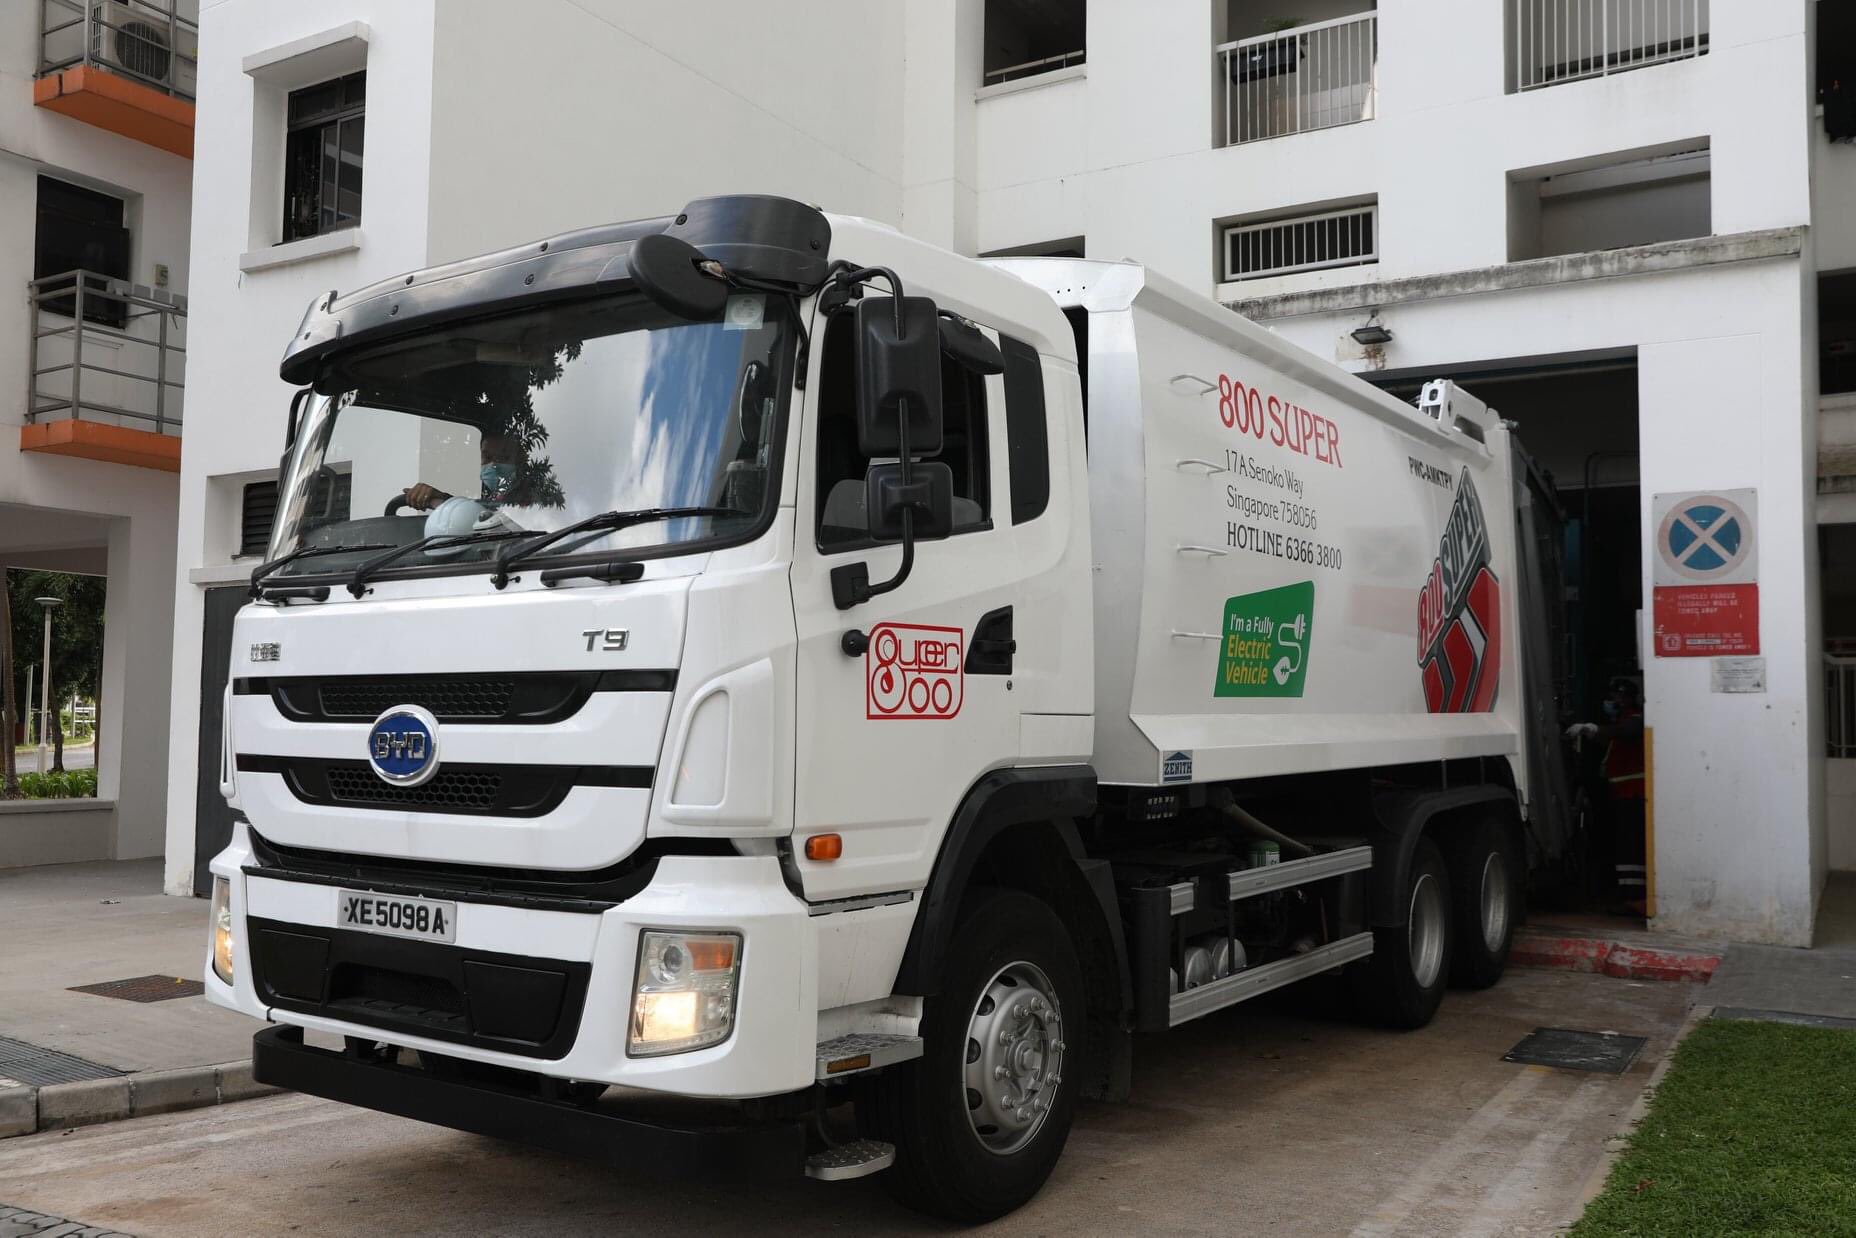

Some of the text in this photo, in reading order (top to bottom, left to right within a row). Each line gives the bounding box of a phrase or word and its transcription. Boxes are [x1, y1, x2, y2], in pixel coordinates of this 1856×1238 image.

[1219, 374, 1342, 468] 800 SUPER
[1226, 449, 1303, 499] 17A Senoko Way
[1227, 485, 1316, 530] Singapore 758056
[1227, 521, 1342, 570] HOTLINE 6366 3800
[1231, 613, 1274, 639] I'm a Fully
[582, 629, 630, 652] T9
[1228, 633, 1272, 660] Electric
[1226, 661, 1268, 685] Vehicle
[374, 731, 426, 759] BYD
[1164, 761, 1192, 775] ZENITH
[347, 897, 445, 935] XE5098A
